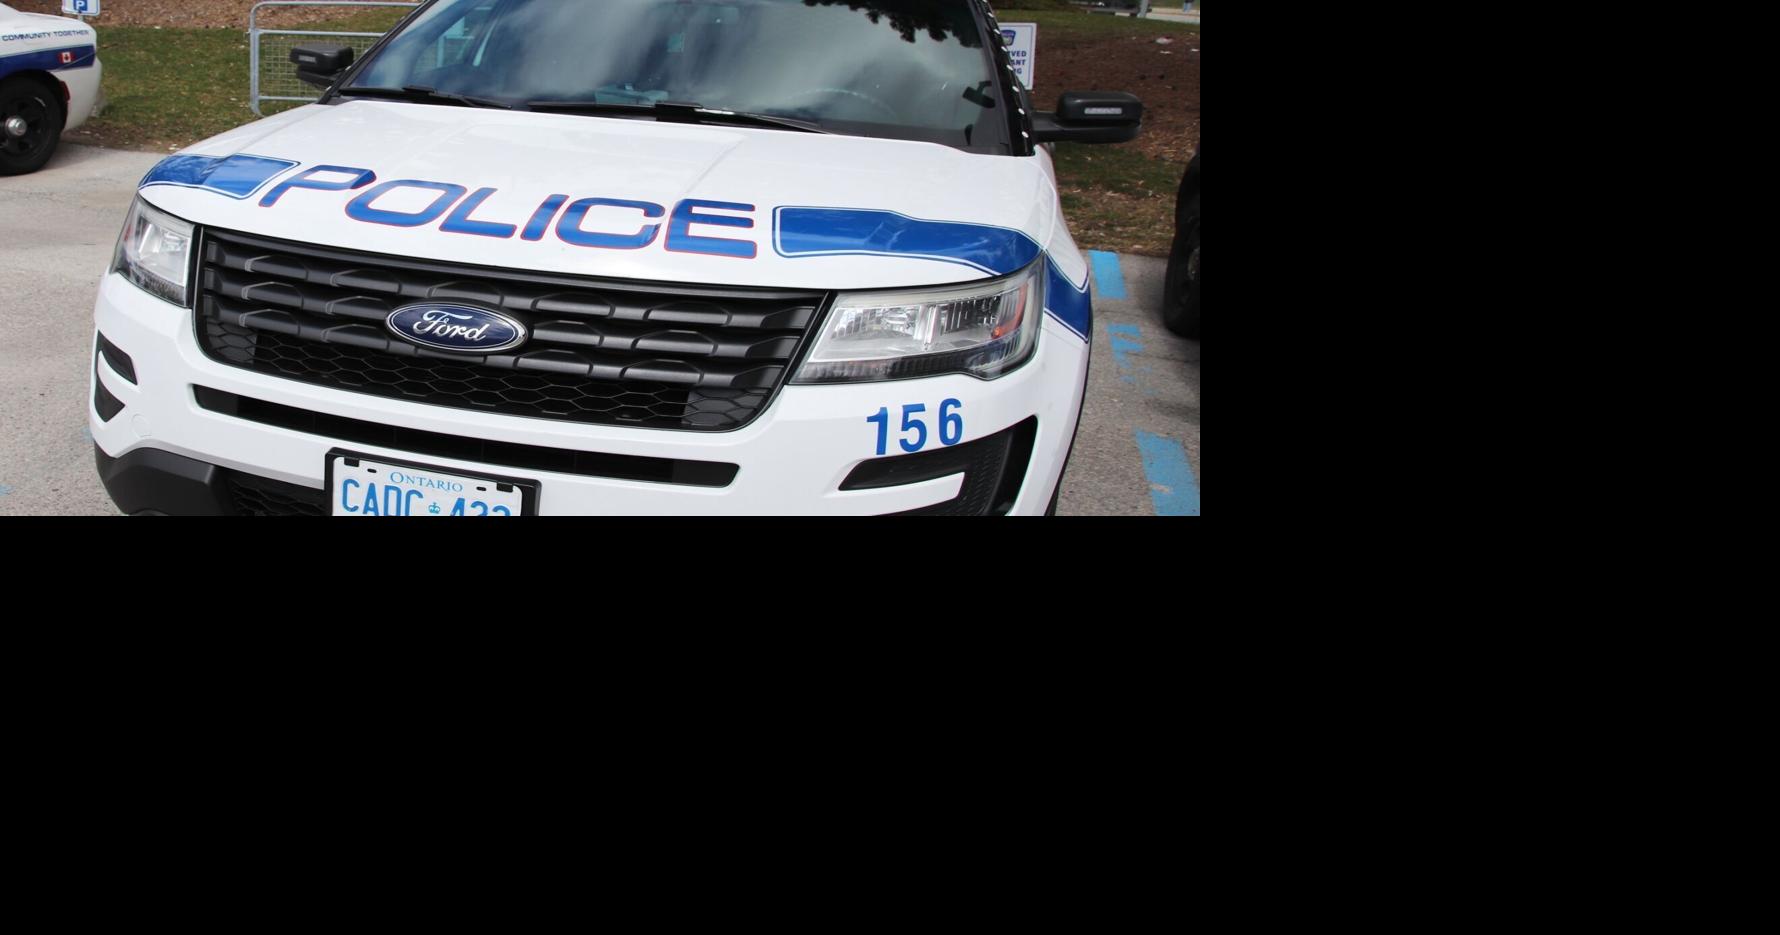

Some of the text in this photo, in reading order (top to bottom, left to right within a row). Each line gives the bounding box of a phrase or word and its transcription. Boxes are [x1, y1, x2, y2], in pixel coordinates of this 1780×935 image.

[2, 29, 89, 41] COMMUNITY TOGETHER
[258, 163, 758, 259] POLICE
[412, 309, 491, 341] Ford
[866, 398, 963, 455] 156
